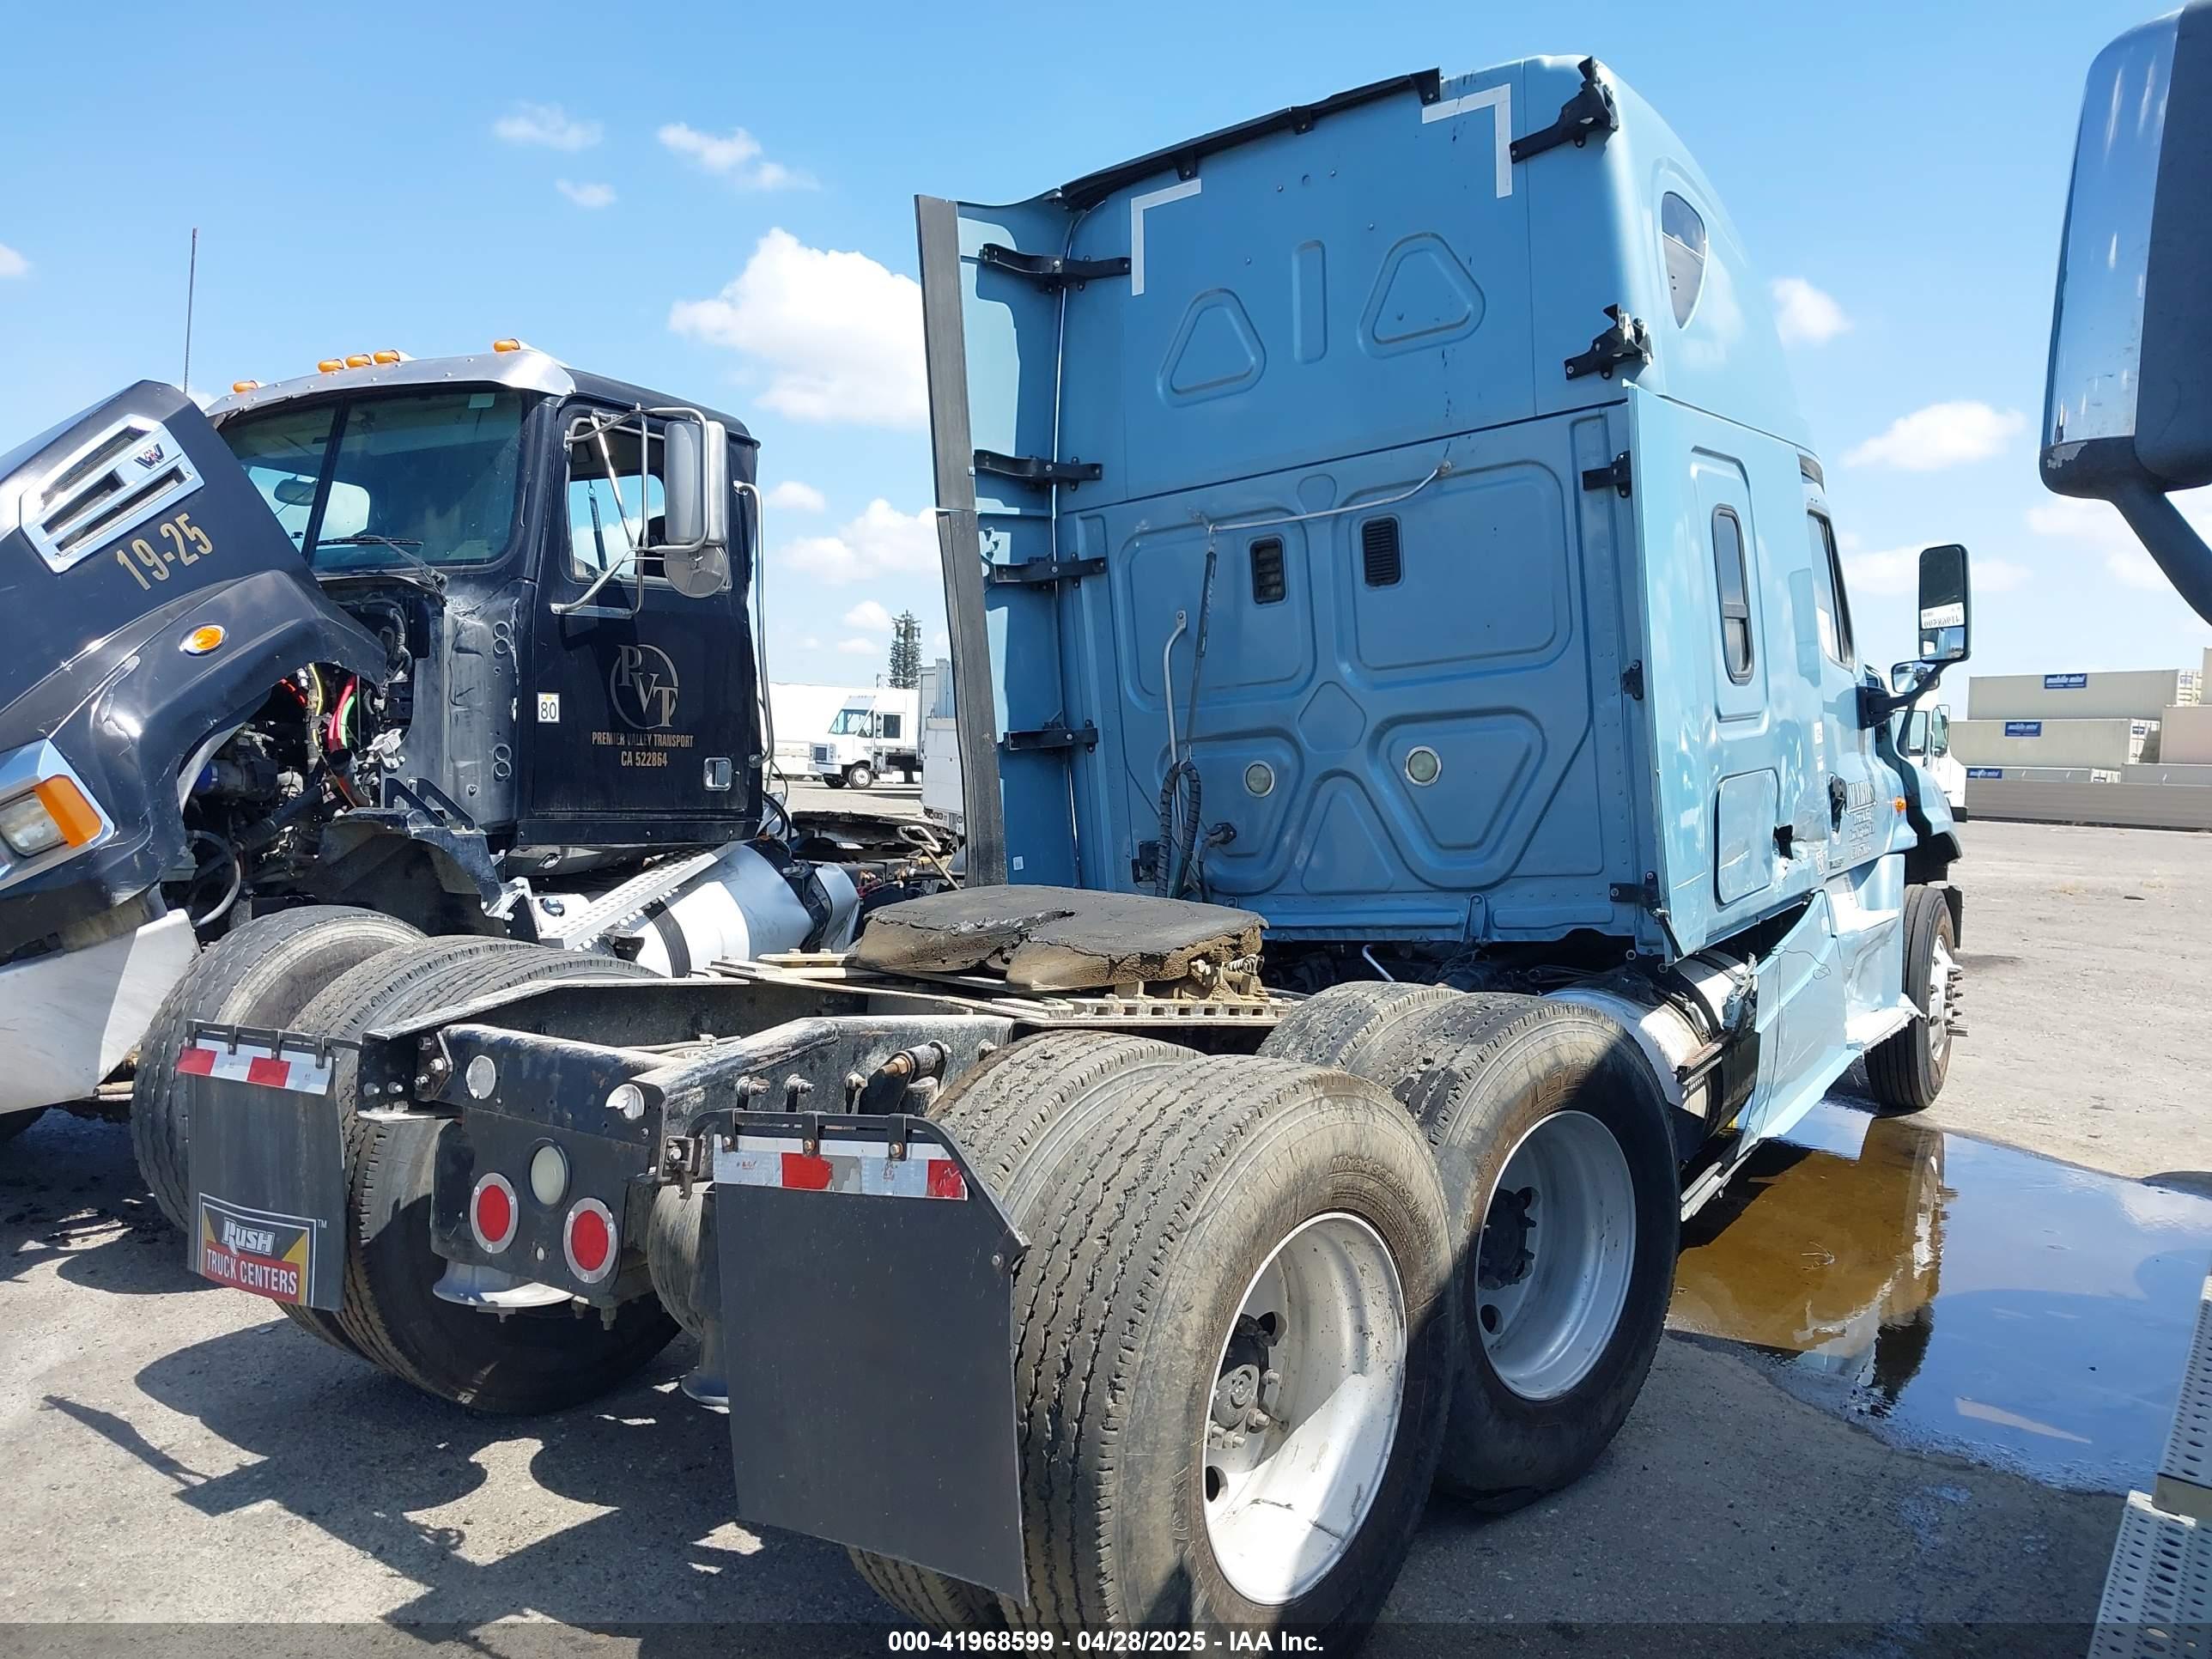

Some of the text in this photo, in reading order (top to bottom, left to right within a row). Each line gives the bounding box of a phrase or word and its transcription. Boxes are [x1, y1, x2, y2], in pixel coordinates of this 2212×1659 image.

[117, 512, 214, 591] 19-25
[540, 702, 557, 720] 80
[592, 732, 694, 748] PREMIER VALLEY TRANSPORT
[621, 750, 669, 768] CA 522864
[206, 1248, 297, 1296] TRUCK CENTERS
